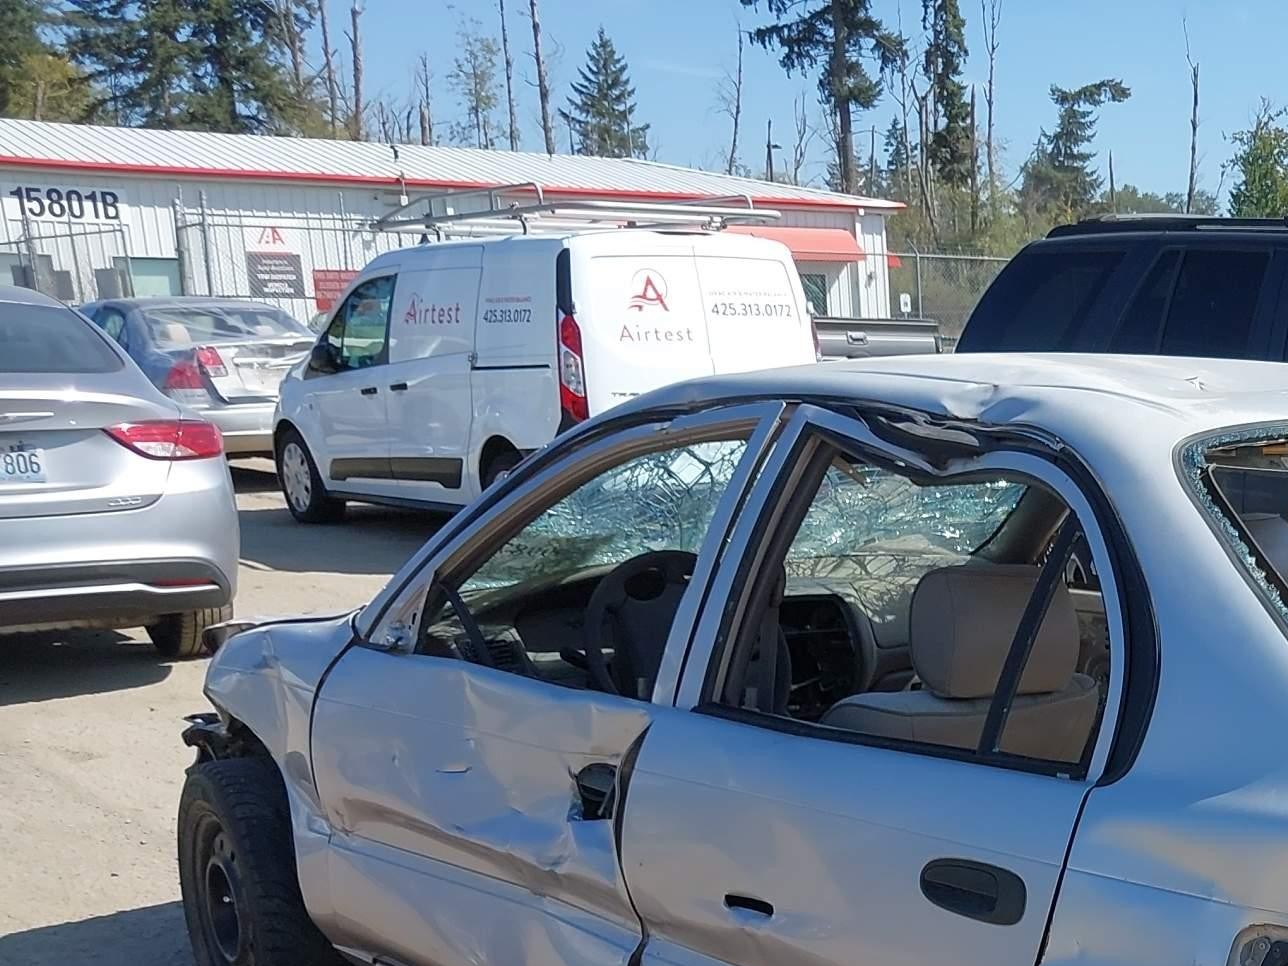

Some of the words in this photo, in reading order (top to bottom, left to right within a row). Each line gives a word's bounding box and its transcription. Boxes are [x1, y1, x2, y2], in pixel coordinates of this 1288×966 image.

[9, 186, 120, 219] 15801B
[404, 297, 461, 325] Airtest
[483, 308, 532, 323] 425.313.0172
[711, 302, 792, 318] 425.313.0172
[619, 324, 695, 343] Airtest
[0, 452, 41, 475] 806
